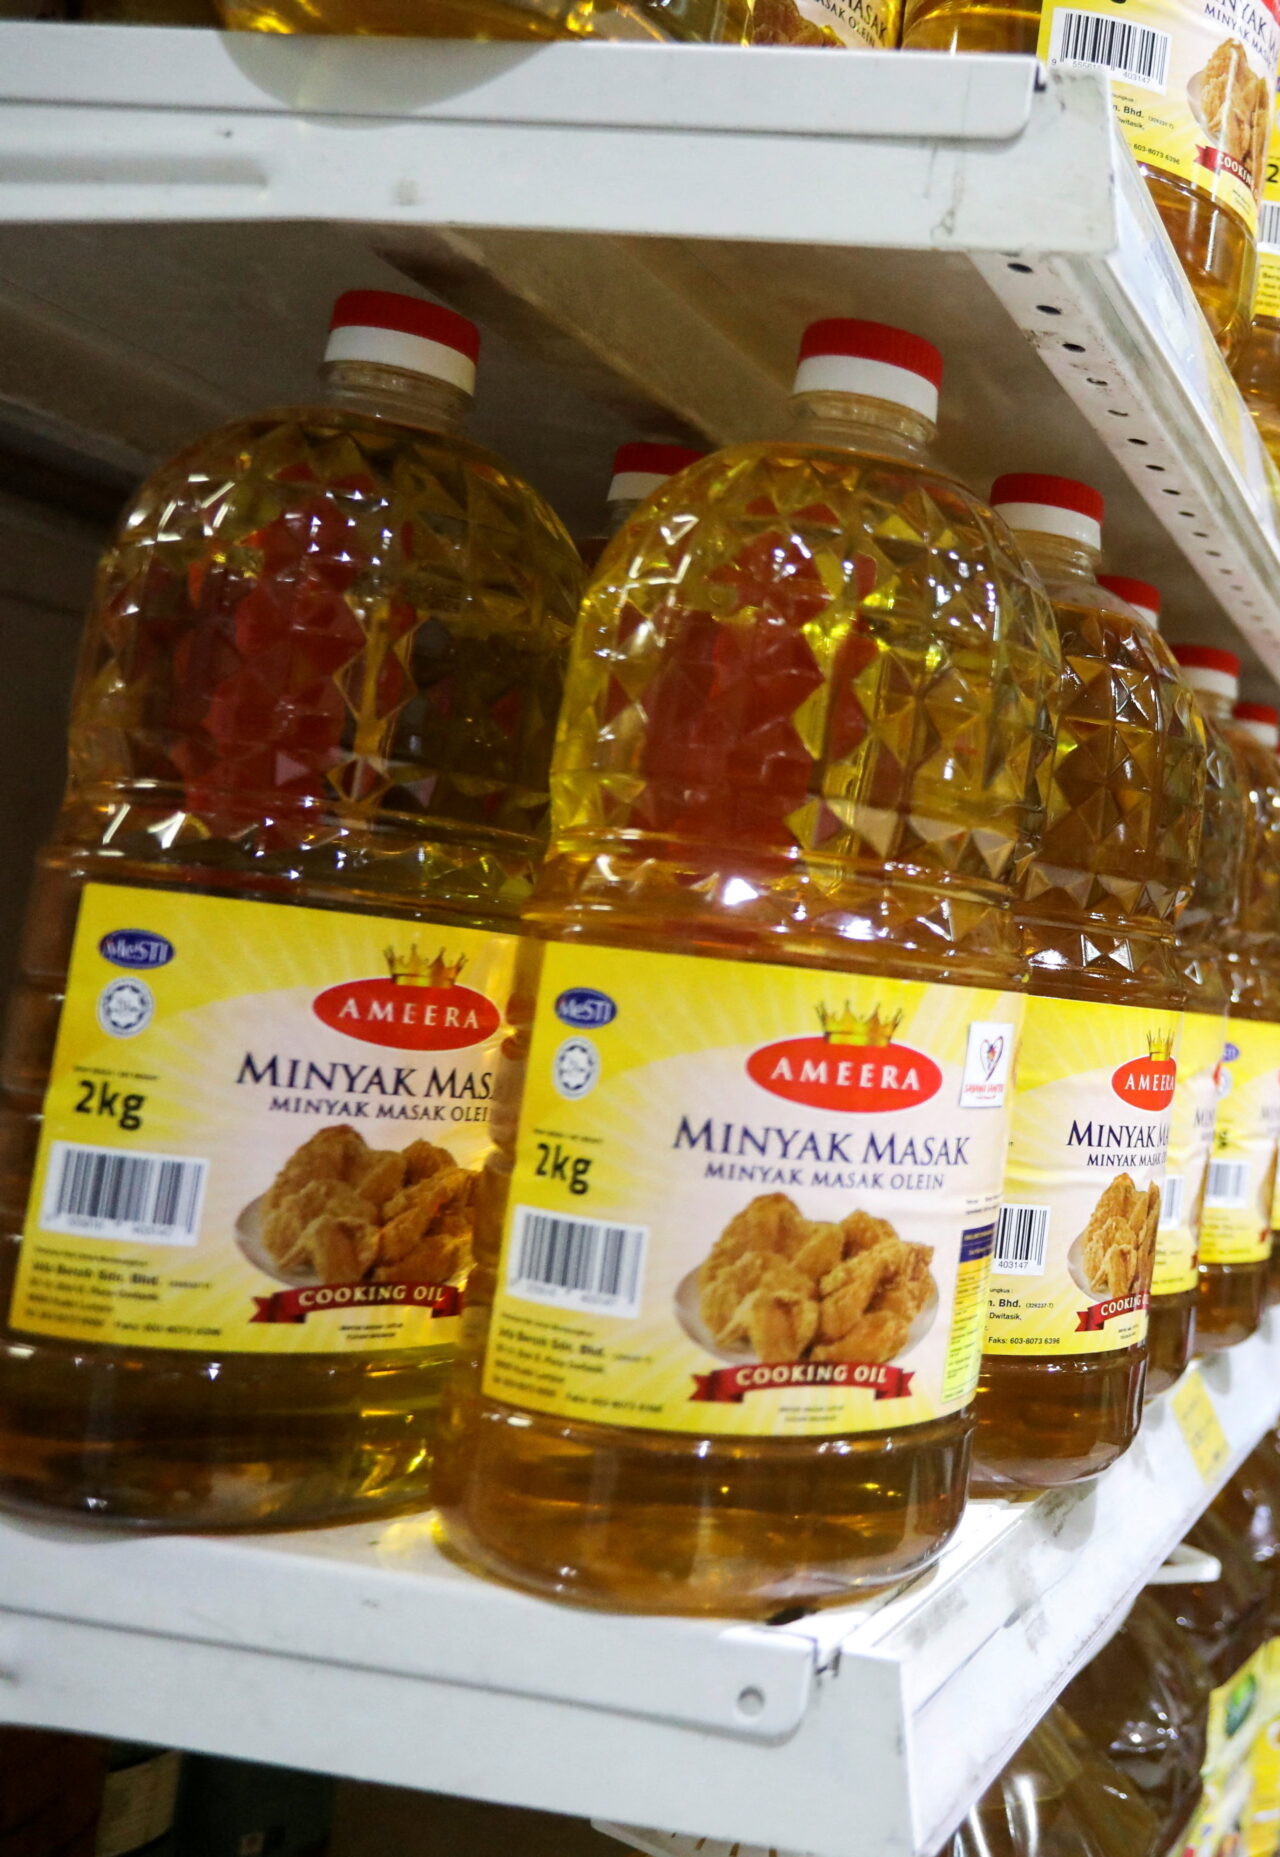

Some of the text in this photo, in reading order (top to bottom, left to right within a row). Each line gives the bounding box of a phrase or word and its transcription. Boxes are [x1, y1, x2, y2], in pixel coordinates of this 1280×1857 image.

[1123, 105, 1145, 118] Bhd.
[338, 998, 479, 1029] AMEERA
[236, 1052, 493, 1100] MINYAK MAS
[769, 1056, 921, 1091] AMEERA
[74, 1079, 147, 1131] 2kg
[268, 1096, 489, 1122] MINYAK MASAK OLEI
[672, 1114, 971, 1167] MINYAK MASAK
[1066, 1119, 1157, 1149] MINYAK
[534, 1142, 593, 1196] 2kg
[1086, 1153, 1137, 1167] MINYAK
[704, 1160, 945, 1191] MINYAK MASAK OLEIN
[997, 1259, 1029, 1270] 403147
[298, 1284, 444, 1307] COOKING OIL
[998, 1298, 1022, 1308] Bhd.
[989, 1311, 1022, 1321] Dwitasik,
[987, 1336, 1008, 1345] Faks:
[1009, 1336, 1042, 1345] 603-8073
[736, 1364, 888, 1386] COOKING OIL
